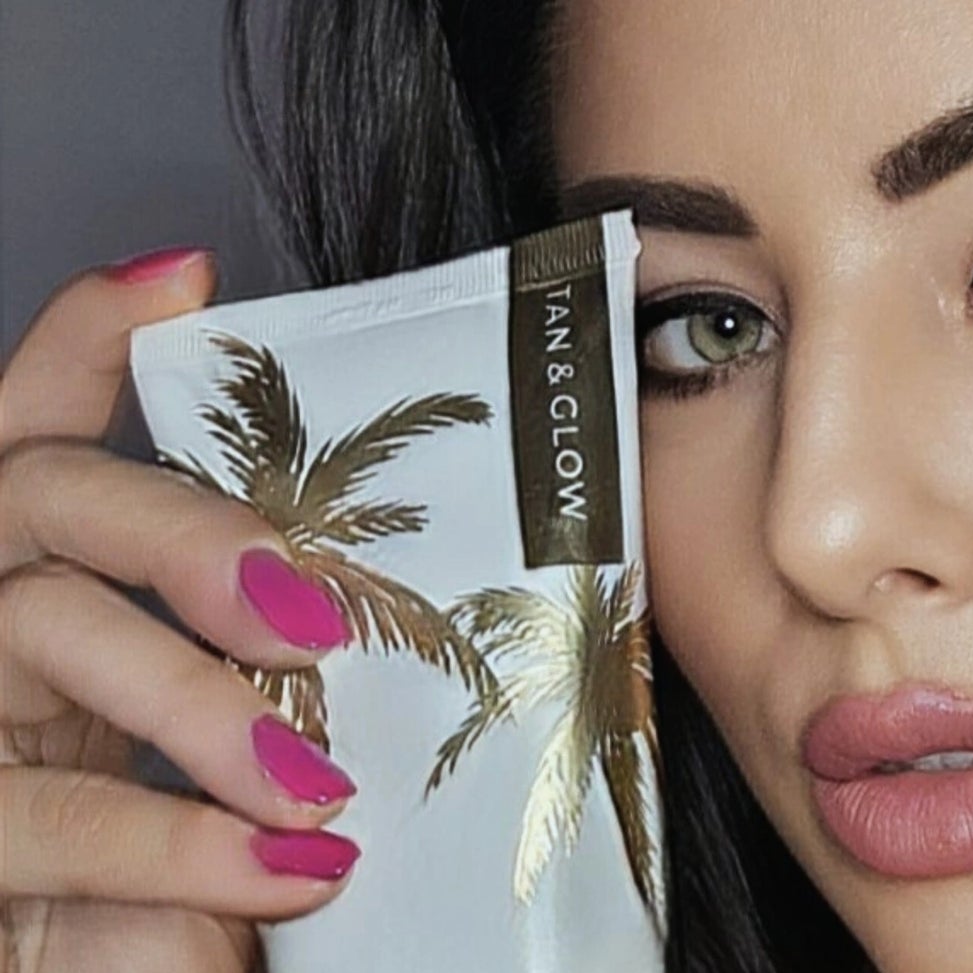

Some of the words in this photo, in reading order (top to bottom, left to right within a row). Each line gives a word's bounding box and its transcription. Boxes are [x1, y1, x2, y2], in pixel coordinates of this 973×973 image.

[544, 284, 572, 352] TAN
[546, 363, 574, 385] &
[550, 395, 588, 521] GLOW
